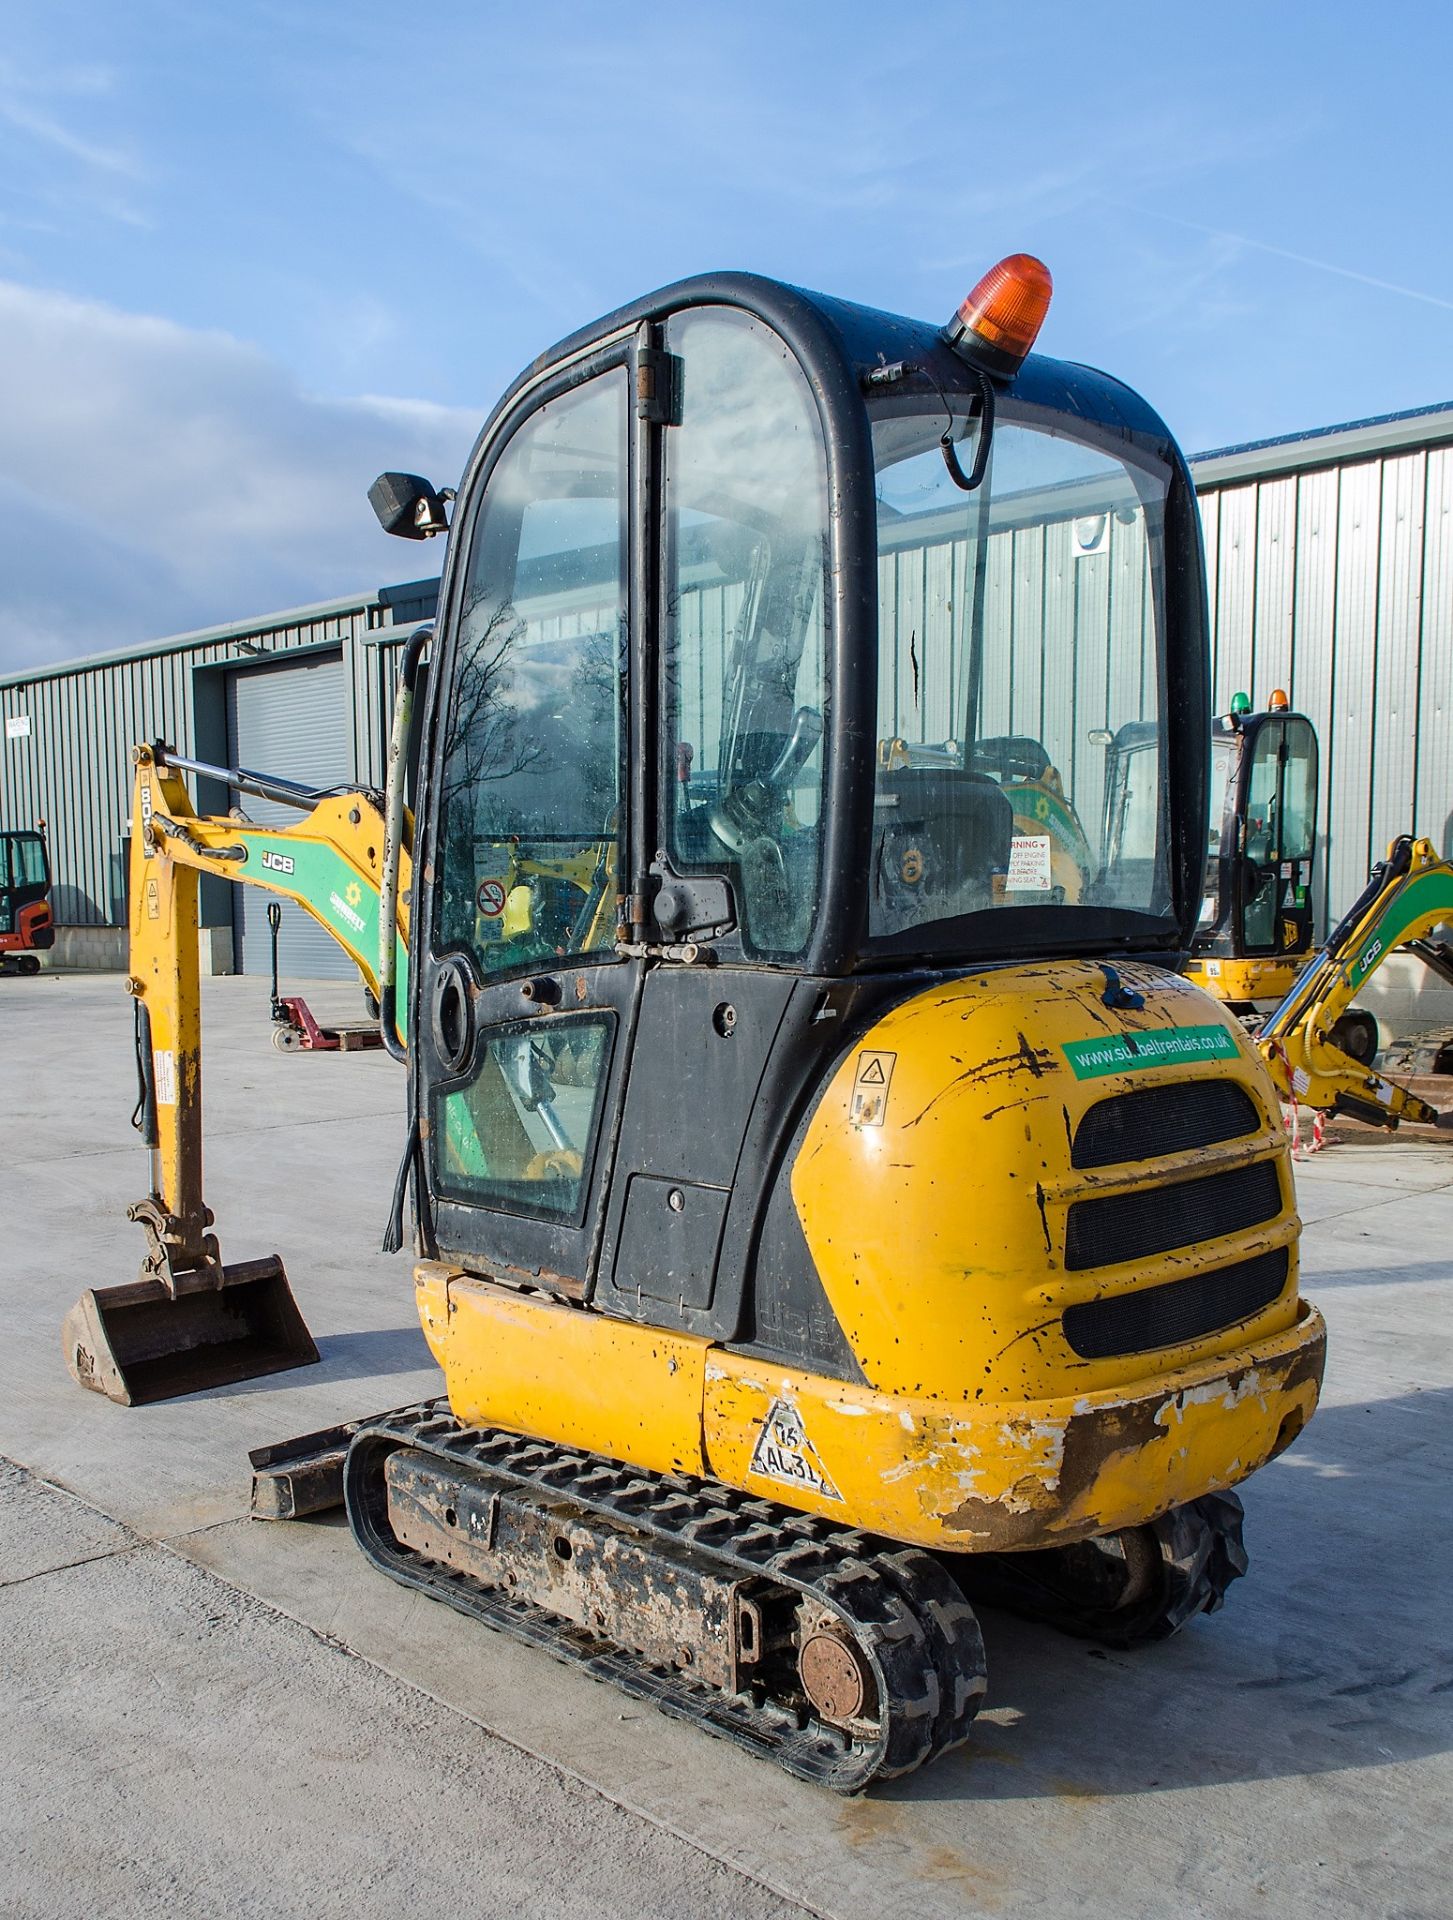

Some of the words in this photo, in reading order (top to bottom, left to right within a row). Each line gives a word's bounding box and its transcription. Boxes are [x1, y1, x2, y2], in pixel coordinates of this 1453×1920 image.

[1009, 841, 1038, 849] RNING
[1024, 851, 1046, 859] ENGINE
[262, 851, 294, 875] JCB
[1360, 939, 1383, 973] JCB
[1075, 1033, 1230, 1067] www.subeltrentals.co.uk
